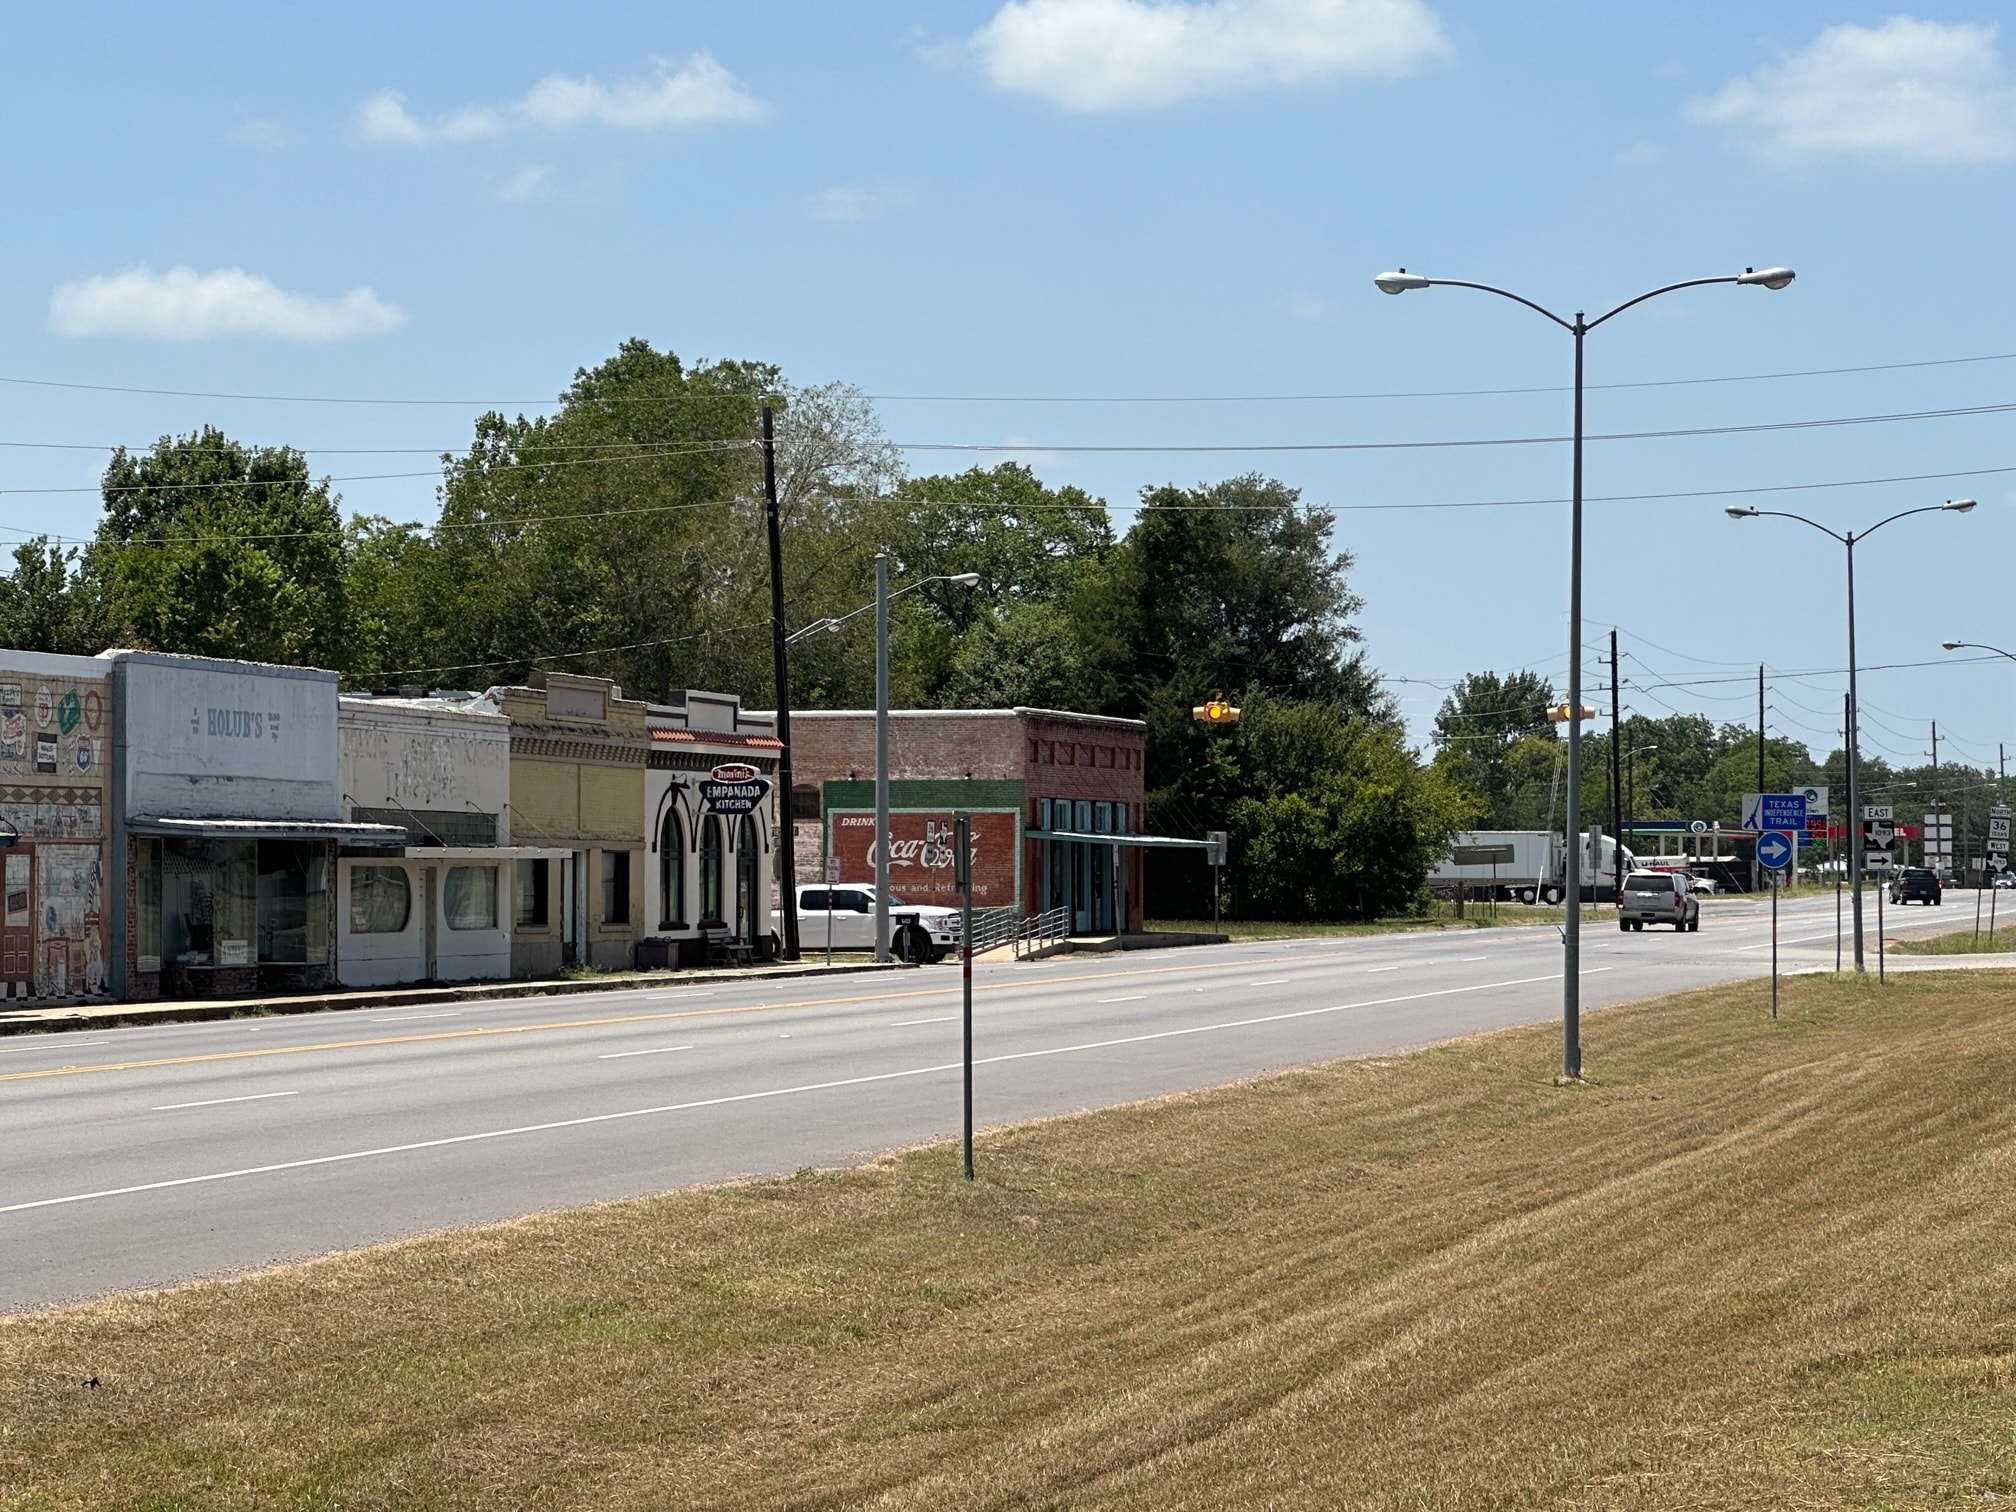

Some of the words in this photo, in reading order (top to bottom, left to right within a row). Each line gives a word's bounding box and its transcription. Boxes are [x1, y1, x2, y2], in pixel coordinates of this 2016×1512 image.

[207, 708, 263, 739] HOLUB'S
[706, 786, 760, 798] EMPANADA
[715, 799, 752, 809] KITCHEN
[1769, 800, 1800, 809] TEXAS
[1764, 809, 1804, 817] INDEPENDENCE
[1868, 807, 1889, 818] EAST
[841, 817, 877, 827] DRINK
[1770, 817, 1798, 826] TRAIL
[1992, 820, 2007, 831] 36
[1990, 841, 2006, 849] WEST
[911, 884, 928, 892] and
[934, 883, 987, 895] Refring
